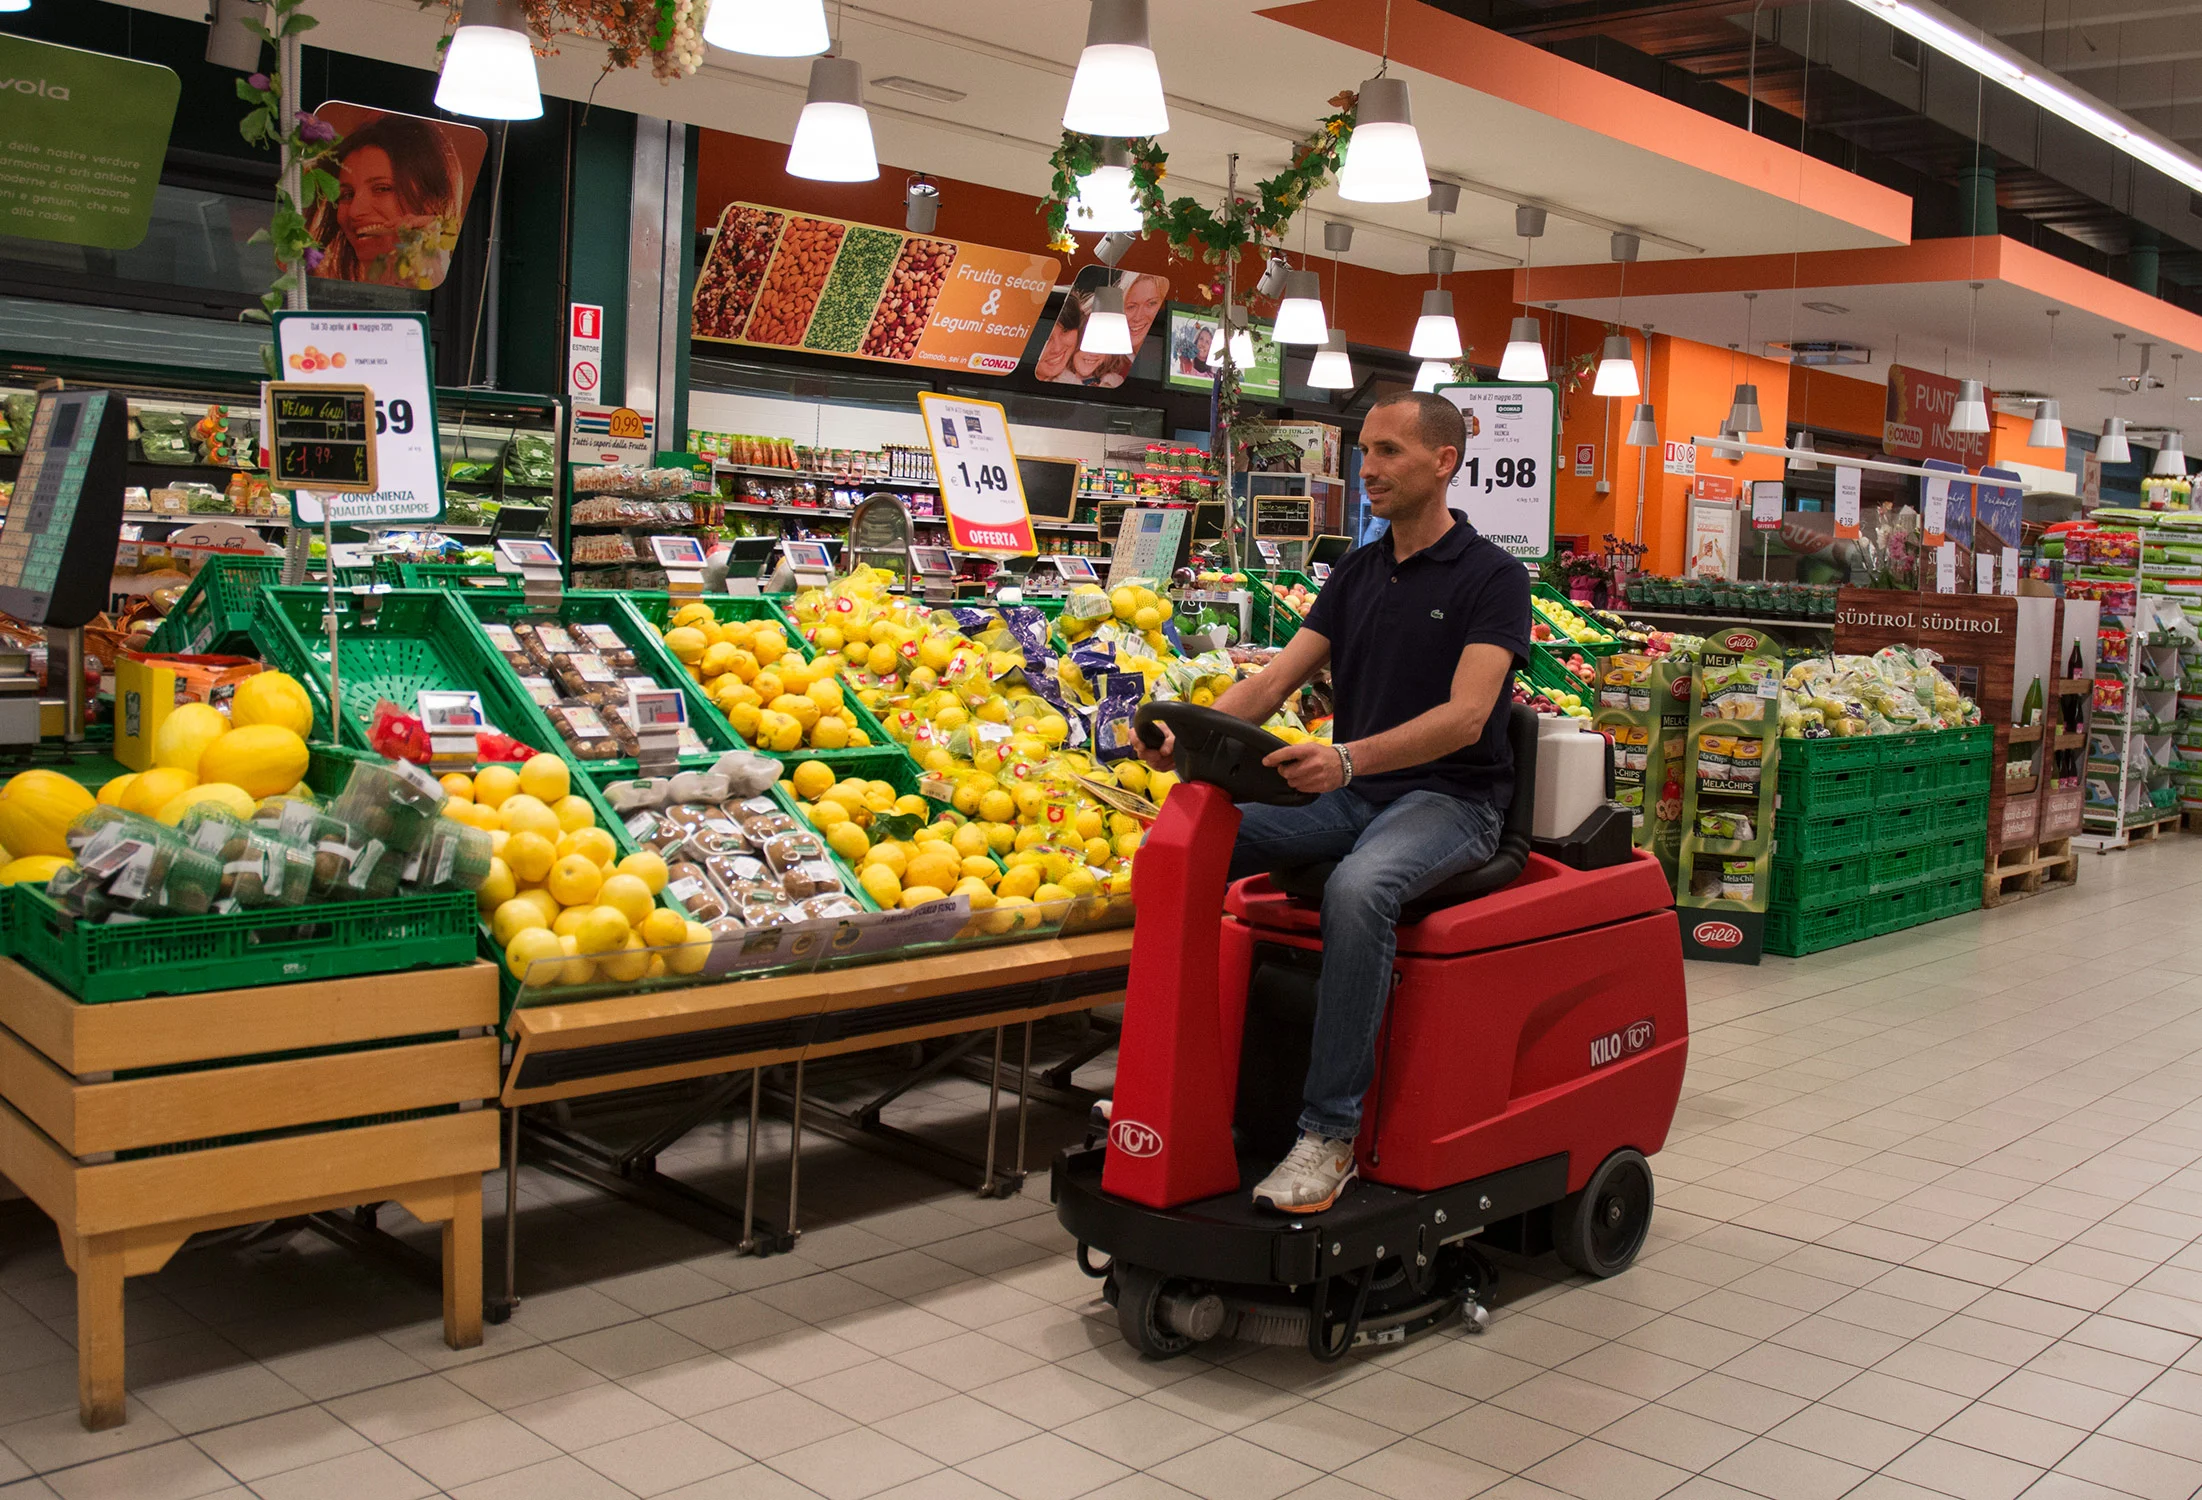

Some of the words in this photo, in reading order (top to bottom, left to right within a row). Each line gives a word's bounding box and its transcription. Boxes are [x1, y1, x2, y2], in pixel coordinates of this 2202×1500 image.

[92, 155, 140, 169] verdure
[94, 171, 137, 185] antiche
[957, 264, 1002, 285] Frutta
[1005, 275, 1046, 293] secca
[981, 289, 1001, 316] &
[932, 312, 985, 333] Legumi
[985, 322, 1030, 339] secchi
[572, 344, 600, 353] ESTINTORE
[981, 358, 1016, 370] CONAD
[1915, 384, 1960, 415] PUNT
[612, 416, 639, 434] 0,99
[1894, 427, 1920, 445] CONAD
[958, 461, 1008, 494] 1,49
[1466, 457, 1536, 494] 1,98
[342, 491, 414, 502] CONVENIENZA
[376, 505, 387, 514] DI
[389, 503, 430, 514] SEMPRE
[969, 530, 1018, 546] OFFERTA
[1508, 546, 1540, 555] SEMPRE
[1727, 636, 1754, 648] Gilli
[1703, 779, 1753, 790] MELA-CHIPS
[1698, 926, 1737, 943] Gilli
[1591, 1033, 1621, 1067] KILO
